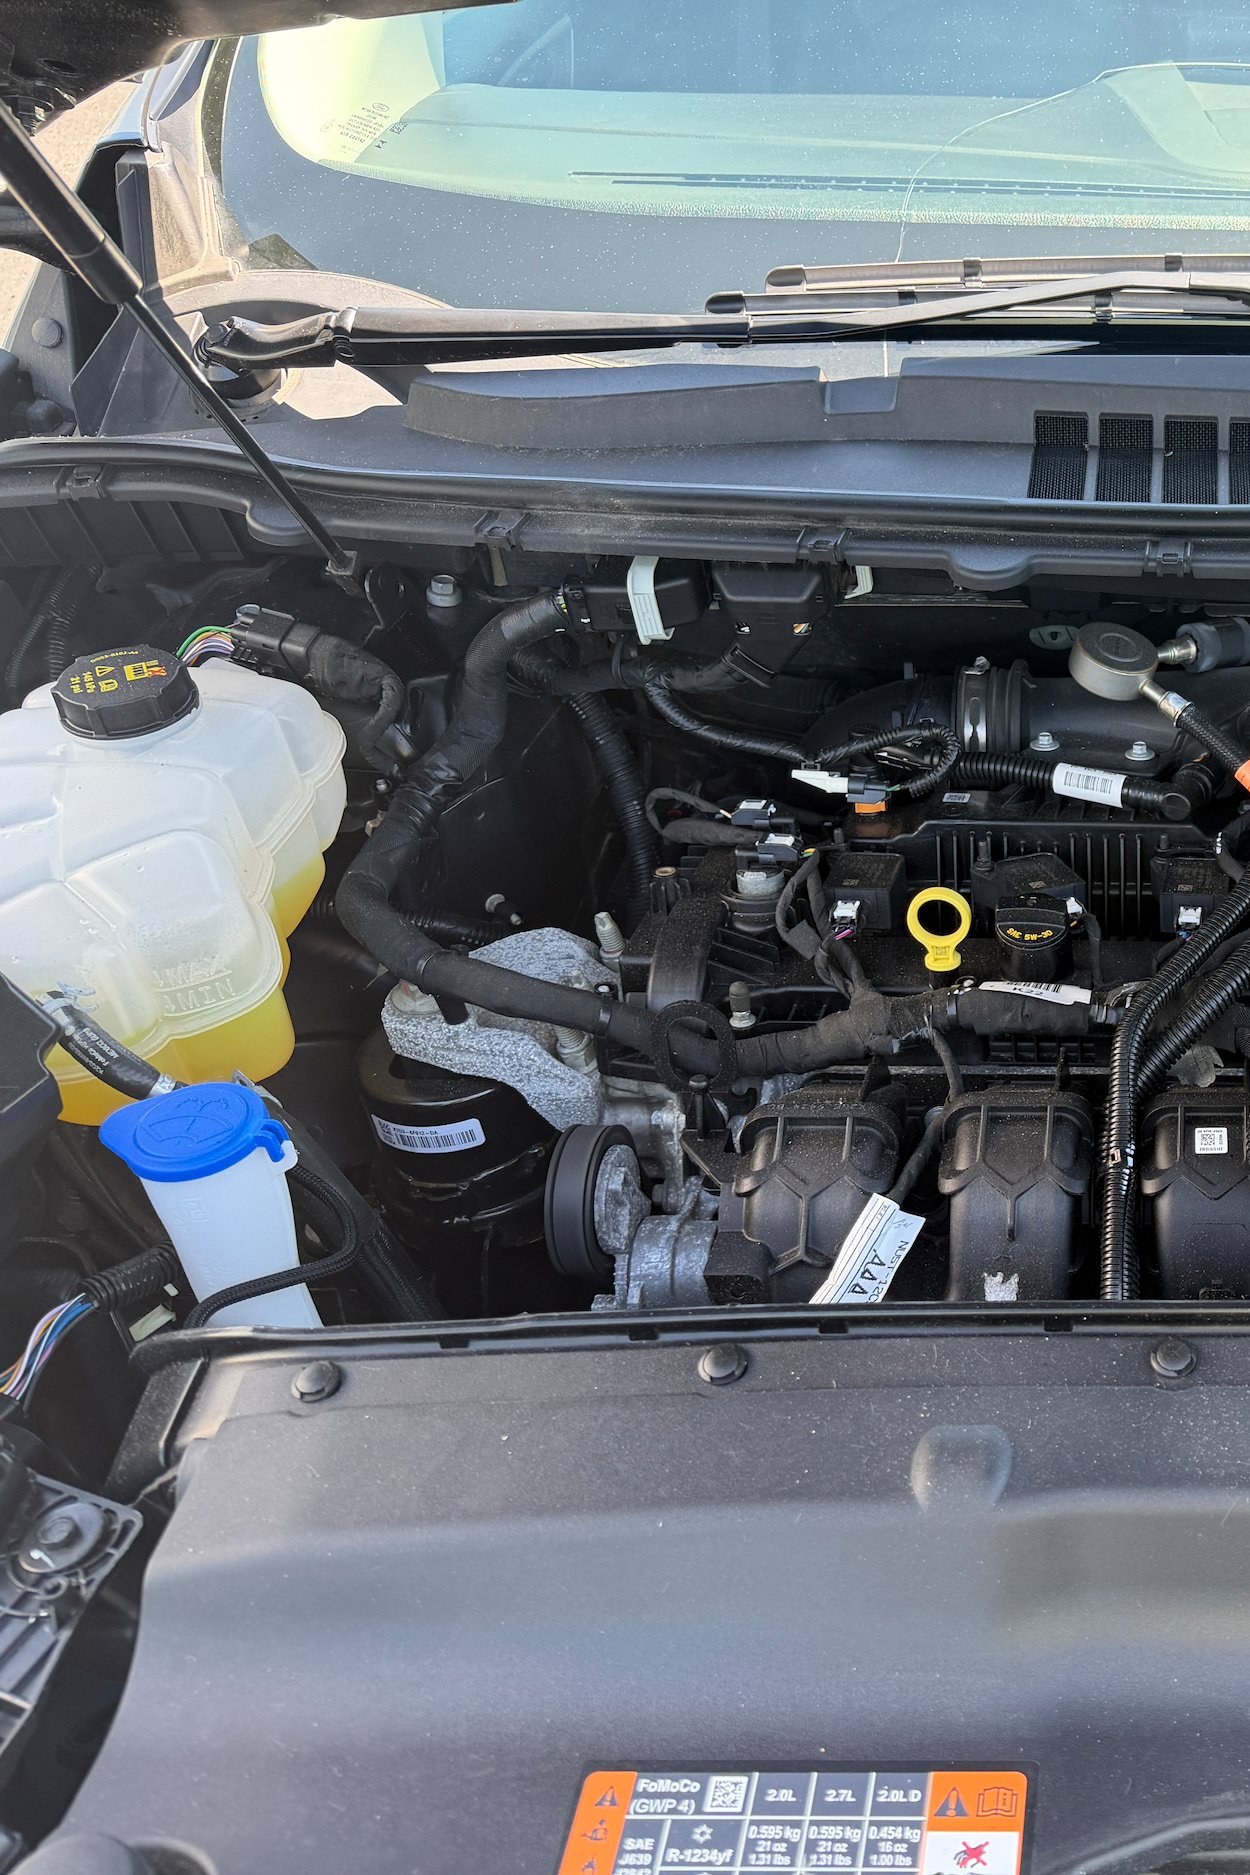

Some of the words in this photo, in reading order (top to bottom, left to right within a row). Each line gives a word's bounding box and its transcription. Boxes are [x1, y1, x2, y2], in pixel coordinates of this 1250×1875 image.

[1007, 927, 1022, 939] SAE
[1024, 929, 1053, 941] 5W-30
[176, 977, 236, 1011] MIN
[636, 1778, 701, 1793] FoMoCo
[765, 1789, 797, 1802] 2.0L
[825, 1789, 856, 1802] 2.7L
[877, 1789, 907, 1802] 2.0L
[909, 1789, 922, 1802] D
[748, 1825, 783, 1839] 0.595
[784, 1825, 801, 1842] kg
[808, 1825, 843, 1839] 0.595
[844, 1825, 862, 1842] kg
[868, 1826, 902, 1839] 0.454
[903, 1826, 921, 1843] kg
[623, 1837, 655, 1850] SAE
[755, 1841, 772, 1852] 21
[773, 1843, 788, 1852] oz
[817, 1841, 833, 1852] 21
[834, 1843, 848, 1852] oz
[878, 1842, 893, 1853] 16
[894, 1844, 908, 1853] oz
[666, 1848, 734, 1865] R-1234yf
[749, 1854, 772, 1865] 1.31
[773, 1854, 791, 1865] lbs
[810, 1854, 833, 1865] 1.31
[834, 1854, 852, 1865] lbs
[870, 1855, 893, 1866] 1.00
[894, 1855, 912, 1866] lbs
